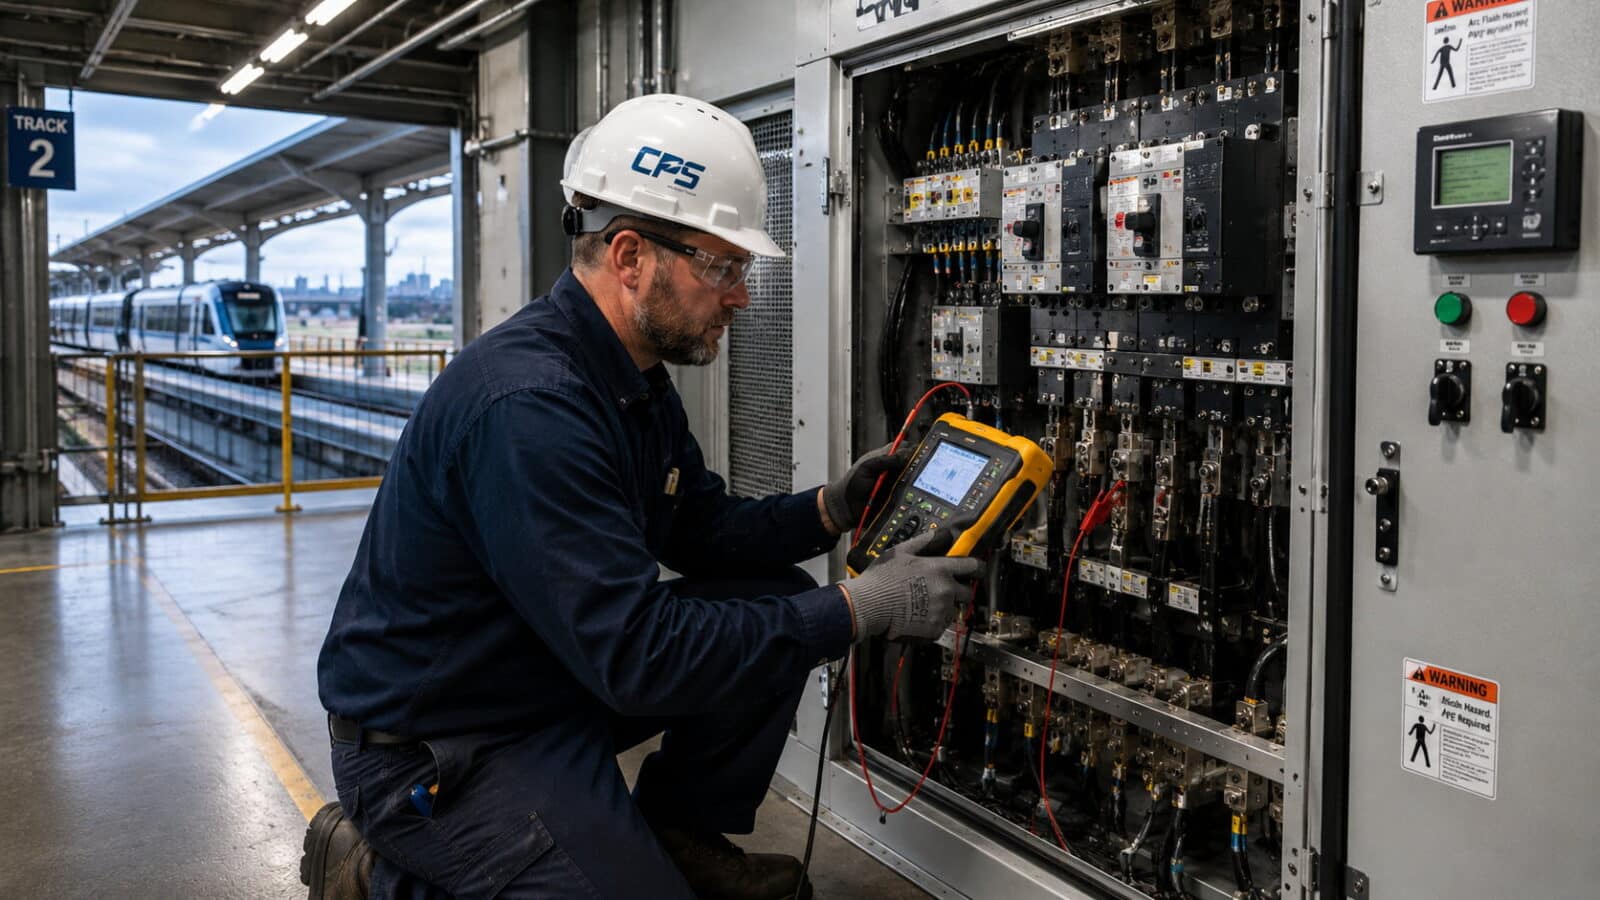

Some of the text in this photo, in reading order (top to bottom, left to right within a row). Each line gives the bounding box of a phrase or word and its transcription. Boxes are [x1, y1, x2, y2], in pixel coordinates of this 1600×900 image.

[13, 114, 68, 134] TRACK
[28, 138, 56, 178] 2
[631, 145, 706, 190] CPS
[1428, 669, 1488, 697] WARNING
